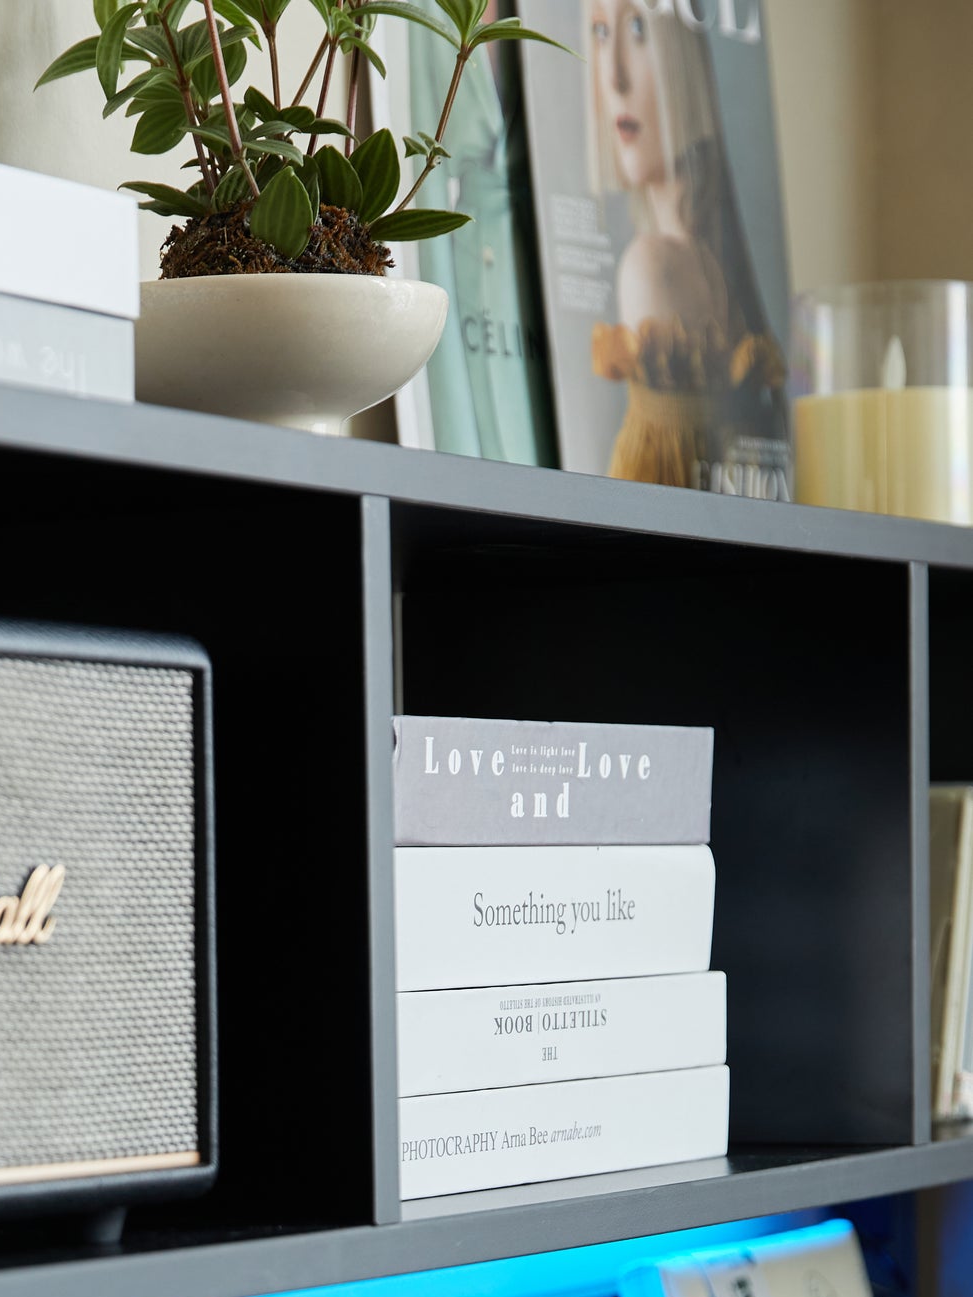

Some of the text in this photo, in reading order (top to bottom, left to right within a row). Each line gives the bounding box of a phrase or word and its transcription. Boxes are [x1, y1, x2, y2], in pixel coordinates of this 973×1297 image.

[424, 736, 652, 780] Love Love
[511, 782, 570, 818] and
[473, 888, 636, 935] Something you like
[494, 1008, 607, 1035] STILETTO BOOK
[542, 1046, 558, 1061] THE
[501, 1130, 526, 1149] Arna
[529, 1126, 548, 1146] Bee
